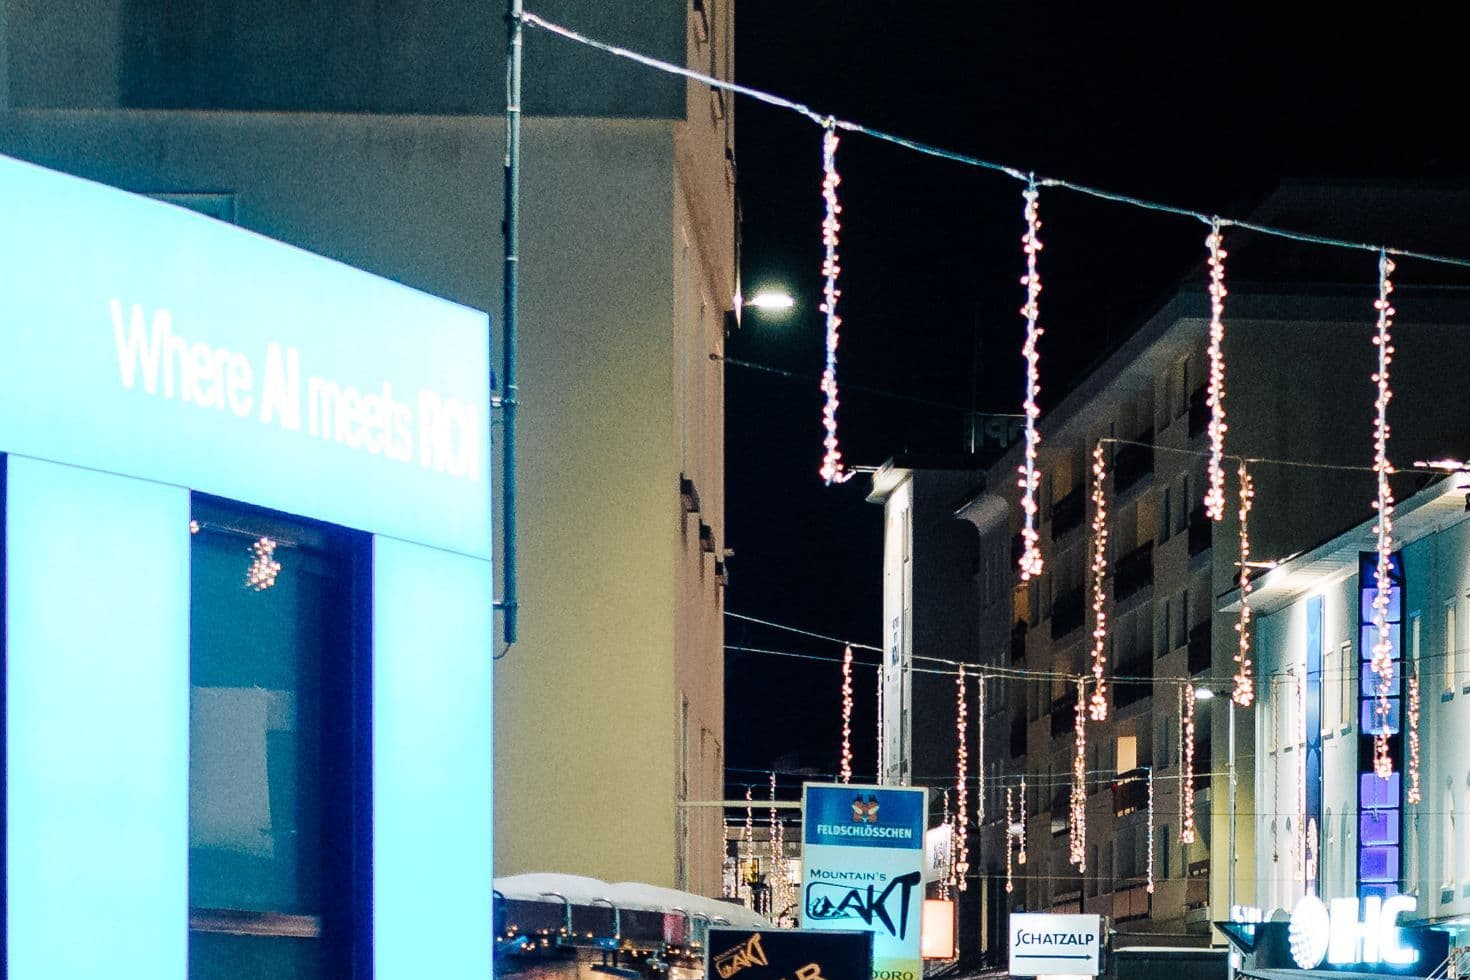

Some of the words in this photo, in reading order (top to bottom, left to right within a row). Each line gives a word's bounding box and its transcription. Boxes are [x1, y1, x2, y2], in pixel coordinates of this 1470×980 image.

[110, 297, 254, 417] Where
[260, 341, 299, 431] AI
[307, 369, 412, 464] meets
[817, 824, 912, 839] FELDSCHLÖSSCHEN
[809, 868, 887, 882] MOUNTAIN'S
[1014, 929, 1094, 947] SCHATZALP
